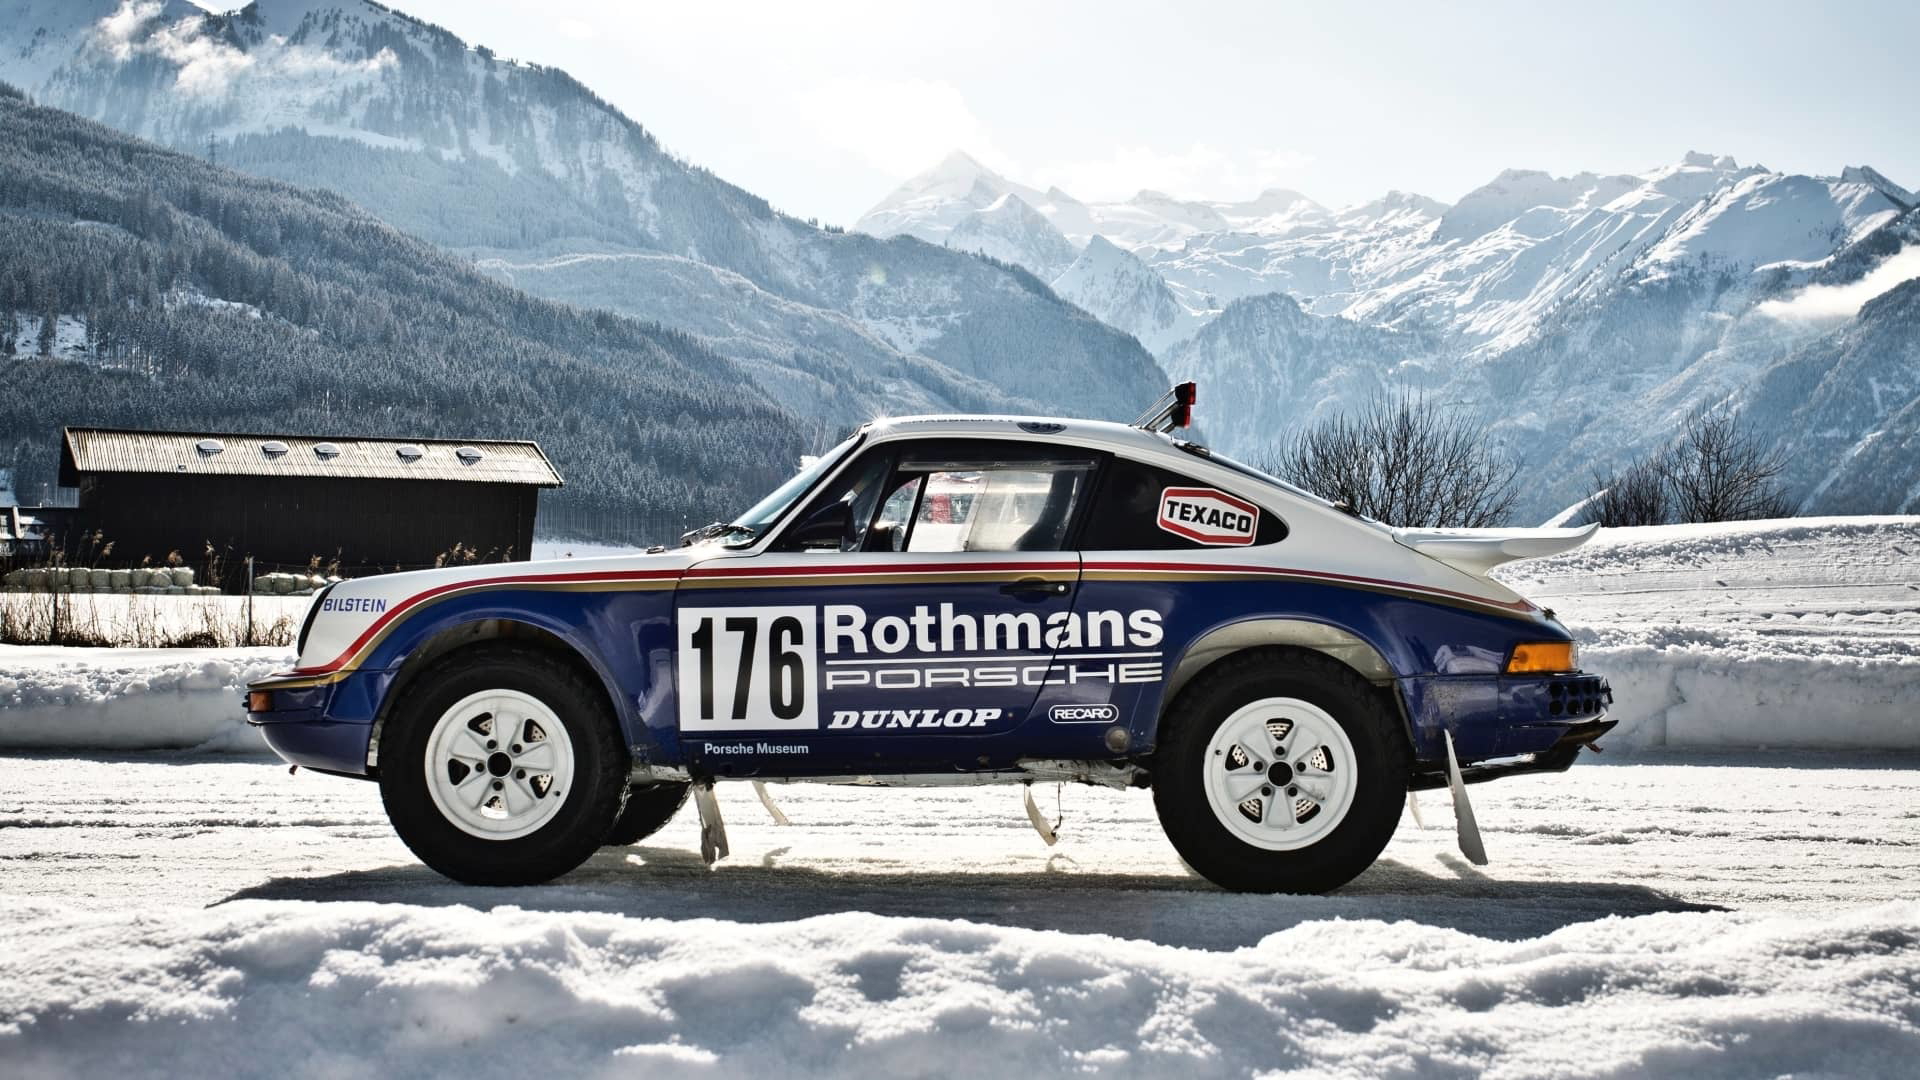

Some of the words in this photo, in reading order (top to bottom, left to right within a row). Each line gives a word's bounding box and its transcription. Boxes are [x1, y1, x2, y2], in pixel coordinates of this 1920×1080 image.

[1167, 500, 1252, 533] TEXACO
[323, 598, 387, 612] BILSTEIN
[823, 603, 1164, 654] Rothmans
[691, 616, 805, 720] 176
[826, 662, 1163, 690] PORSCHE
[827, 709, 1002, 729] DUNLOP
[1054, 707, 1113, 720] RECARO
[704, 743, 754, 755] Porsche
[756, 743, 809, 754] Museum
